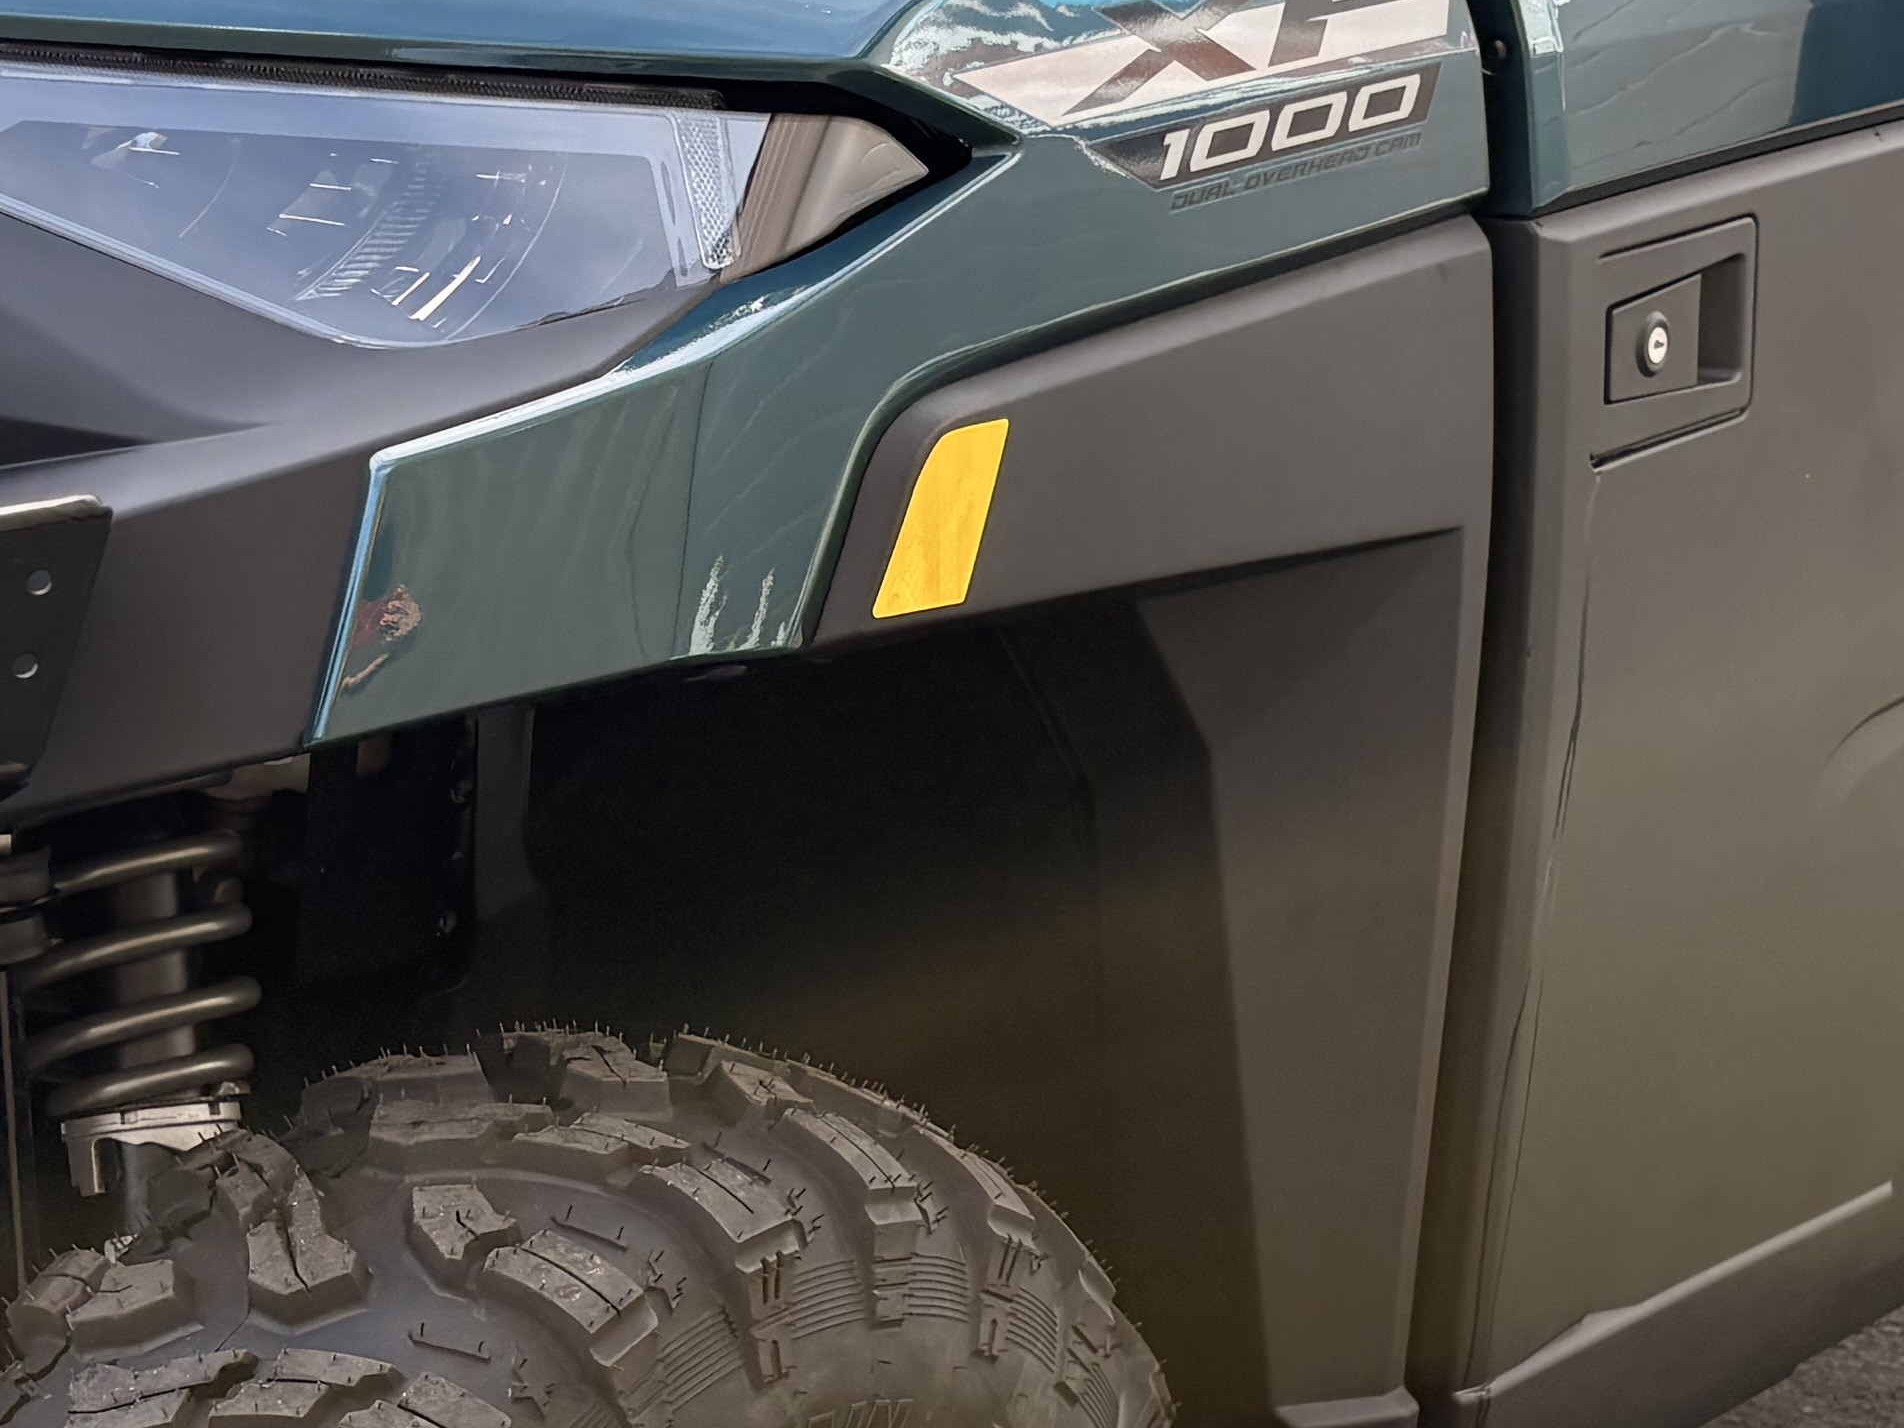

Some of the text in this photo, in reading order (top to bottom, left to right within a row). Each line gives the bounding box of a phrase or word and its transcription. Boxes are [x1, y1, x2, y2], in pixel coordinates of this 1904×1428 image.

[1160, 74, 1421, 180] 1000
[1170, 130, 1423, 211] DUAL OVERHEAD CAM
